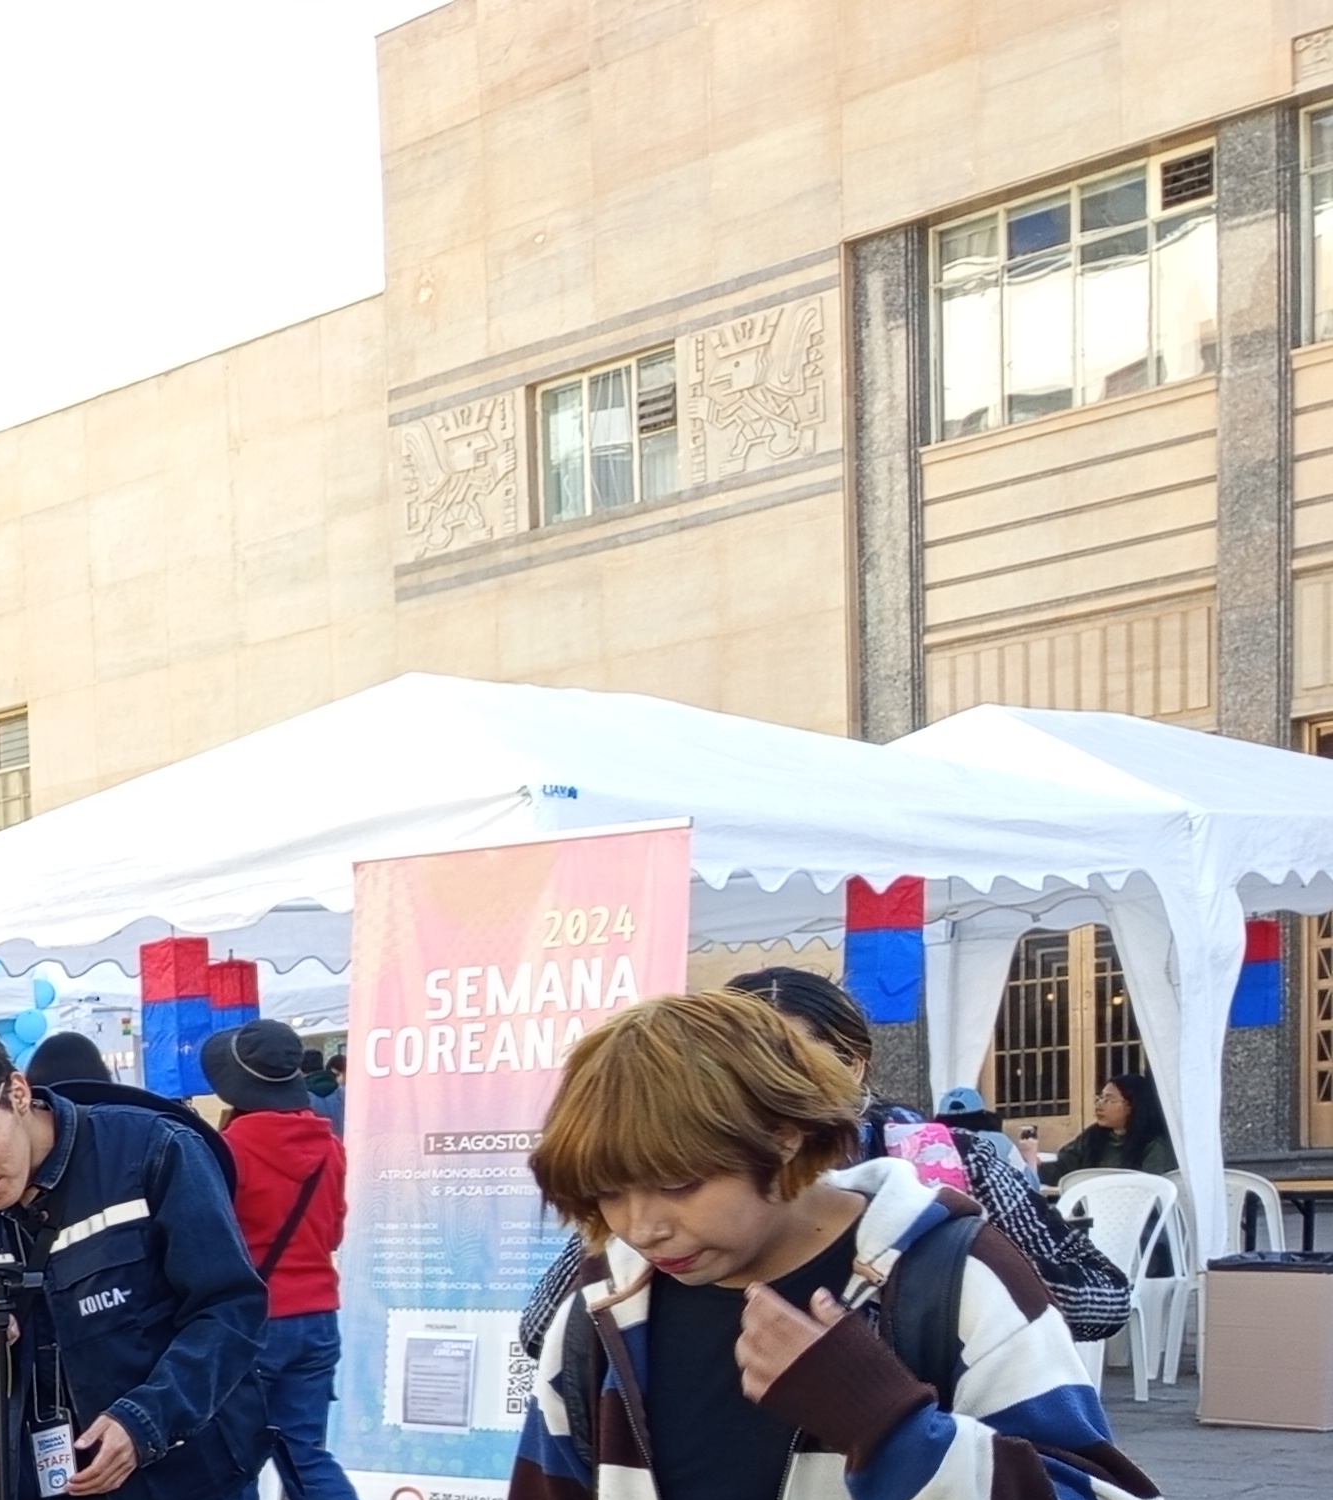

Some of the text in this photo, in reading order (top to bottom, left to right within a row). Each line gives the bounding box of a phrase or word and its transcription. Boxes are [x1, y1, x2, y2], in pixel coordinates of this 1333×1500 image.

[543, 905, 635, 949] 2024
[425, 955, 639, 1020] SEMANA
[432, 1167, 507, 1178] MONOBLOCK
[445, 1186, 482, 1196] PLAZA
[79, 1287, 126, 1317] KOICA
[37, 1454, 71, 1472] STAFF
